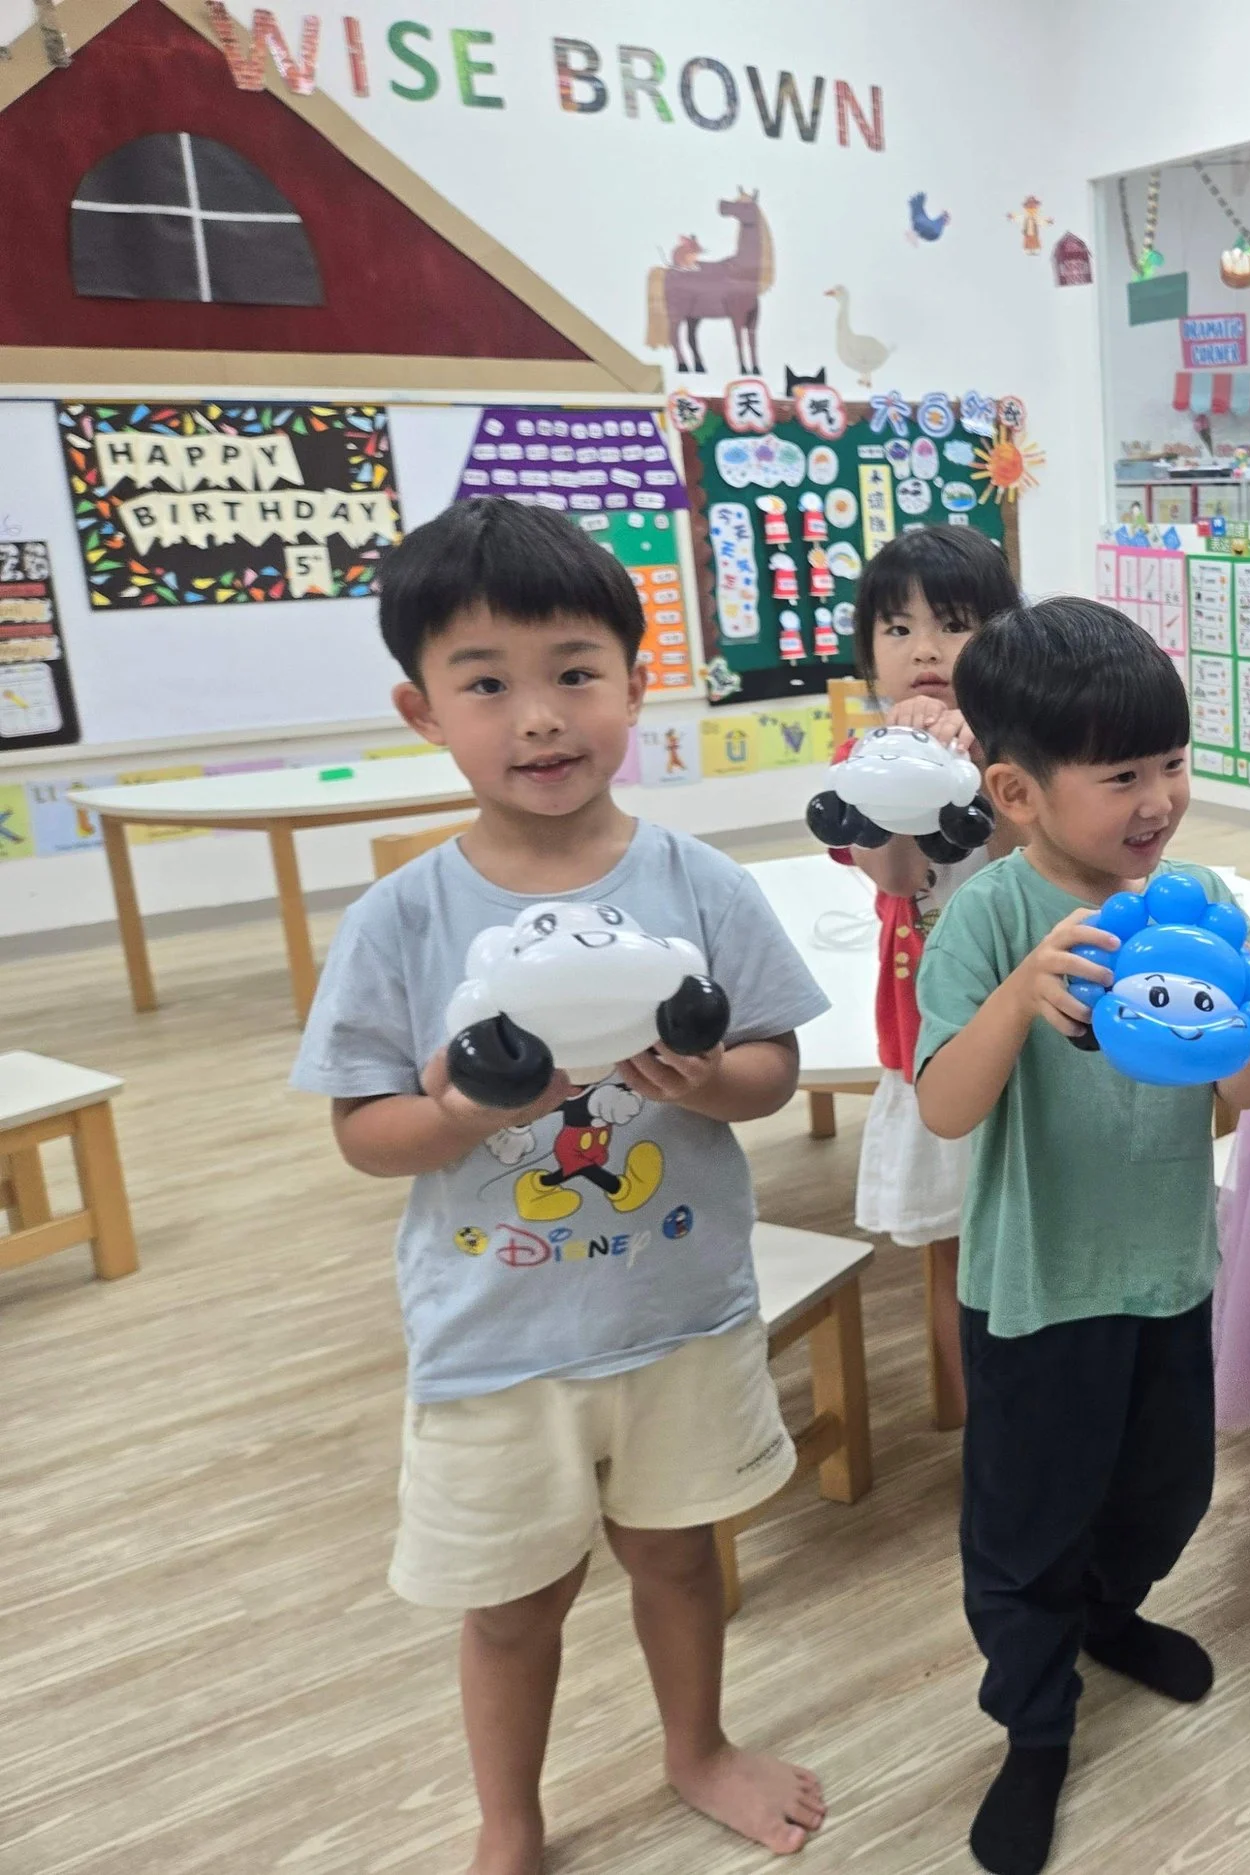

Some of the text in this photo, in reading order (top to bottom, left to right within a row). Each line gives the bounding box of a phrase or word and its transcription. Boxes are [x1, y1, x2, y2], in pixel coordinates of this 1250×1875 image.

[206, 1, 506, 110] WISE
[551, 36, 886, 153] BROWN
[1192, 343, 1238, 363] CORNER
[108, 442, 280, 468] HAPPY
[132, 500, 378, 528] BIRTHDAY
